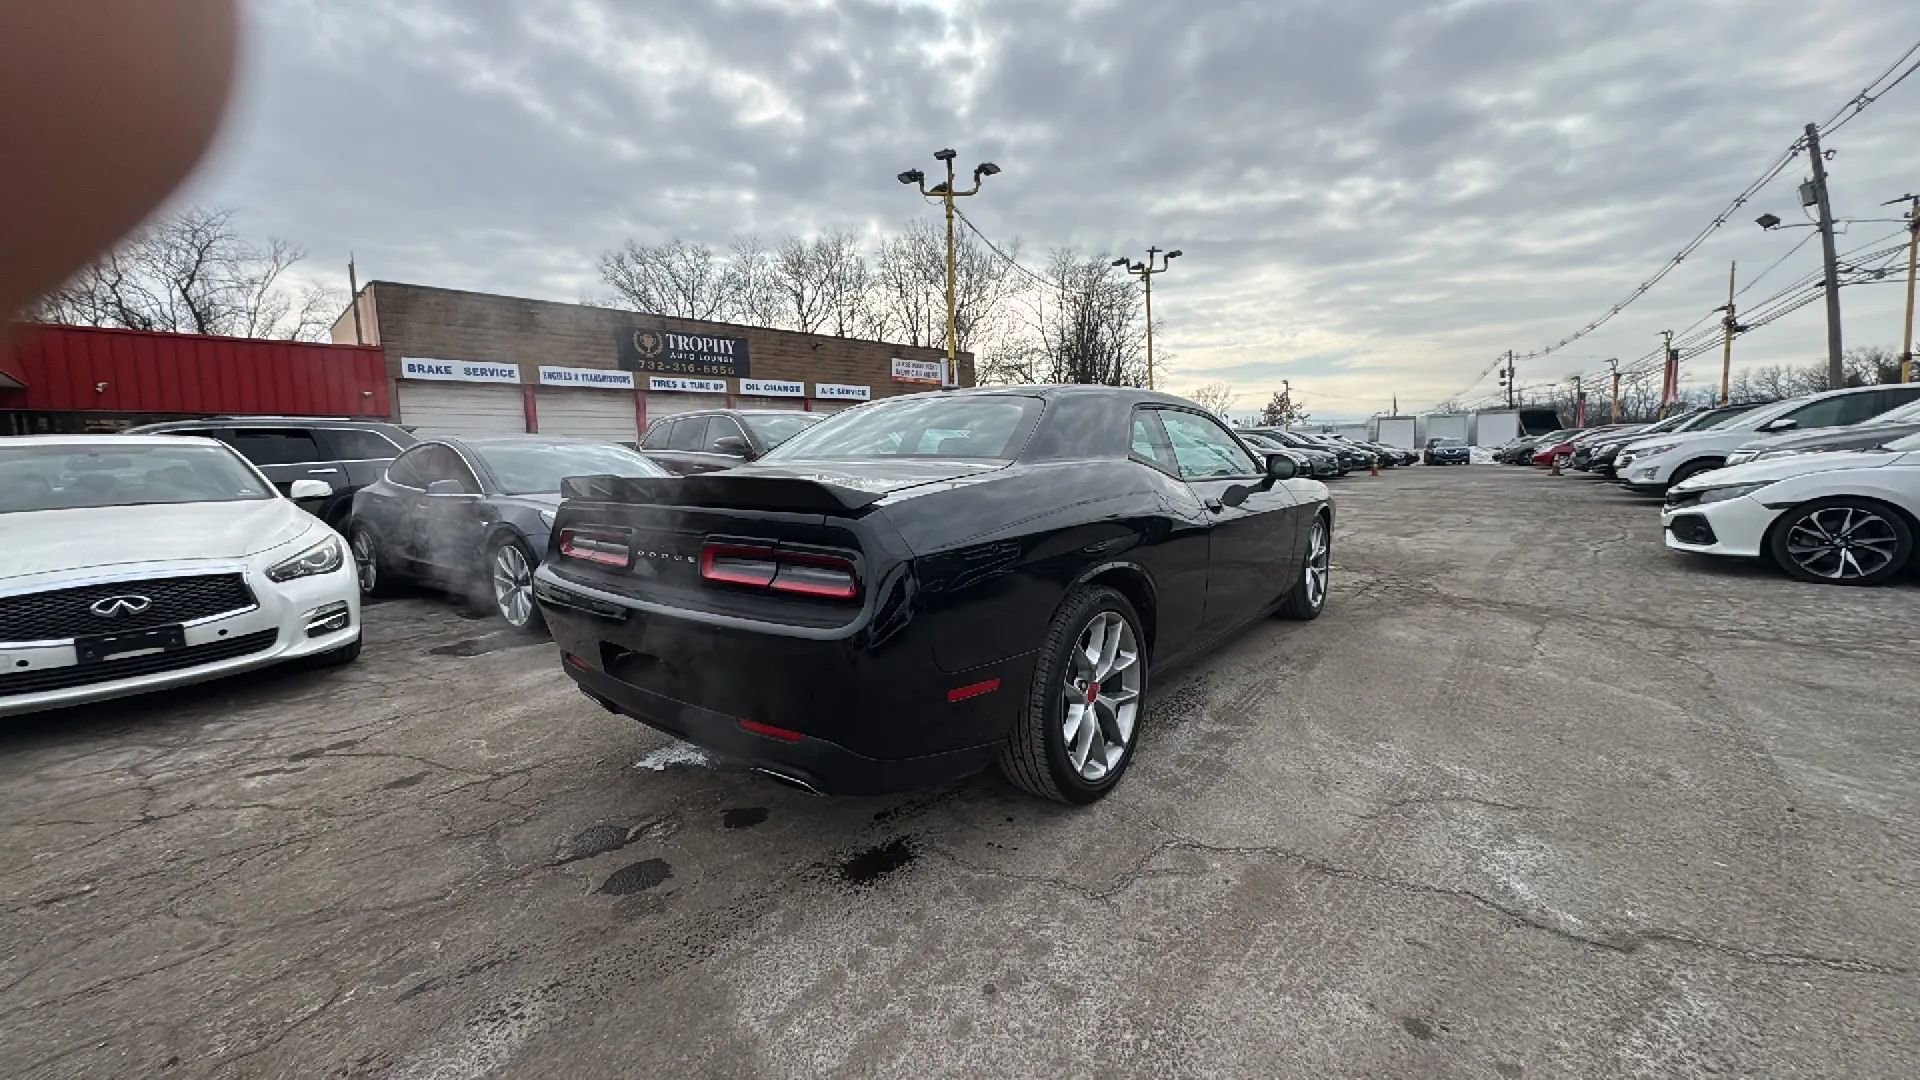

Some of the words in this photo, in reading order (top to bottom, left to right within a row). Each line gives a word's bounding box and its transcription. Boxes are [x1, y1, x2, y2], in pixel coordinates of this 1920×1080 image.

[665, 333, 736, 355] TROPHY
[670, 351, 694, 360] AUTO
[700, 353, 734, 363] LOUNGE
[407, 363, 453, 375] BRAKE
[463, 367, 516, 378] SERVICE
[543, 371, 572, 381] ENGINES
[581, 373, 631, 384] TRANSMISSIONS
[652, 379, 677, 389] TIRES
[681, 381, 686, 389] &
[690, 381, 711, 390] TUNE
[745, 383, 760, 391] OIL
[764, 384, 800, 392] CHANGE
[820, 387, 835, 395] A/C
[837, 388, 867, 396] SERVICE
[637, 550, 696, 563] DODGE
